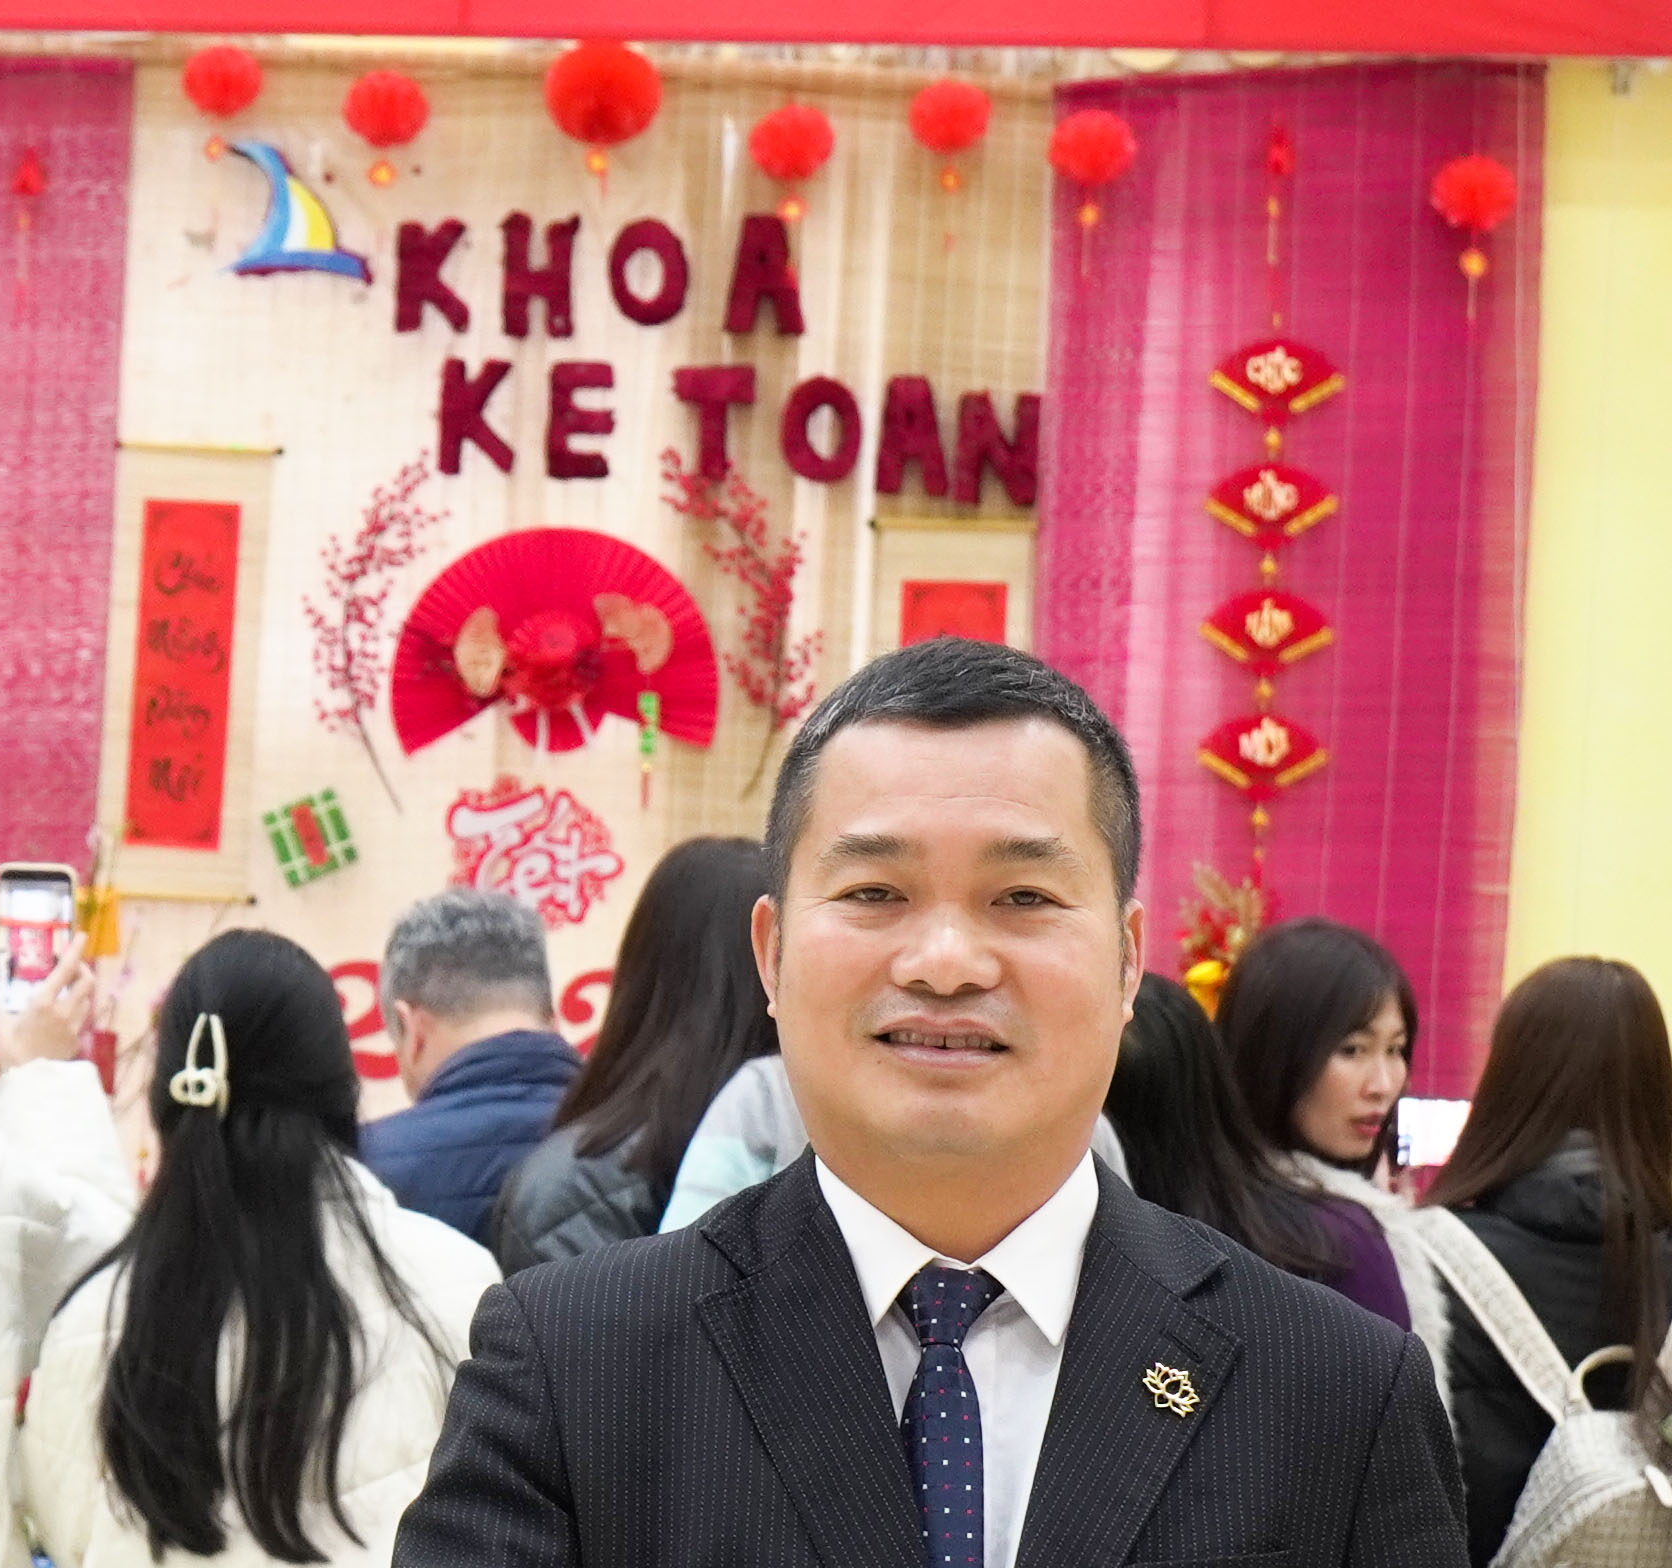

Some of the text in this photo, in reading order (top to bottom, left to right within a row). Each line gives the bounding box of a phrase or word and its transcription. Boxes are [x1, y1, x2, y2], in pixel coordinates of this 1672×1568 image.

[393, 210, 805, 338] KHOA
[436, 358, 1042, 506] KE TOAN
